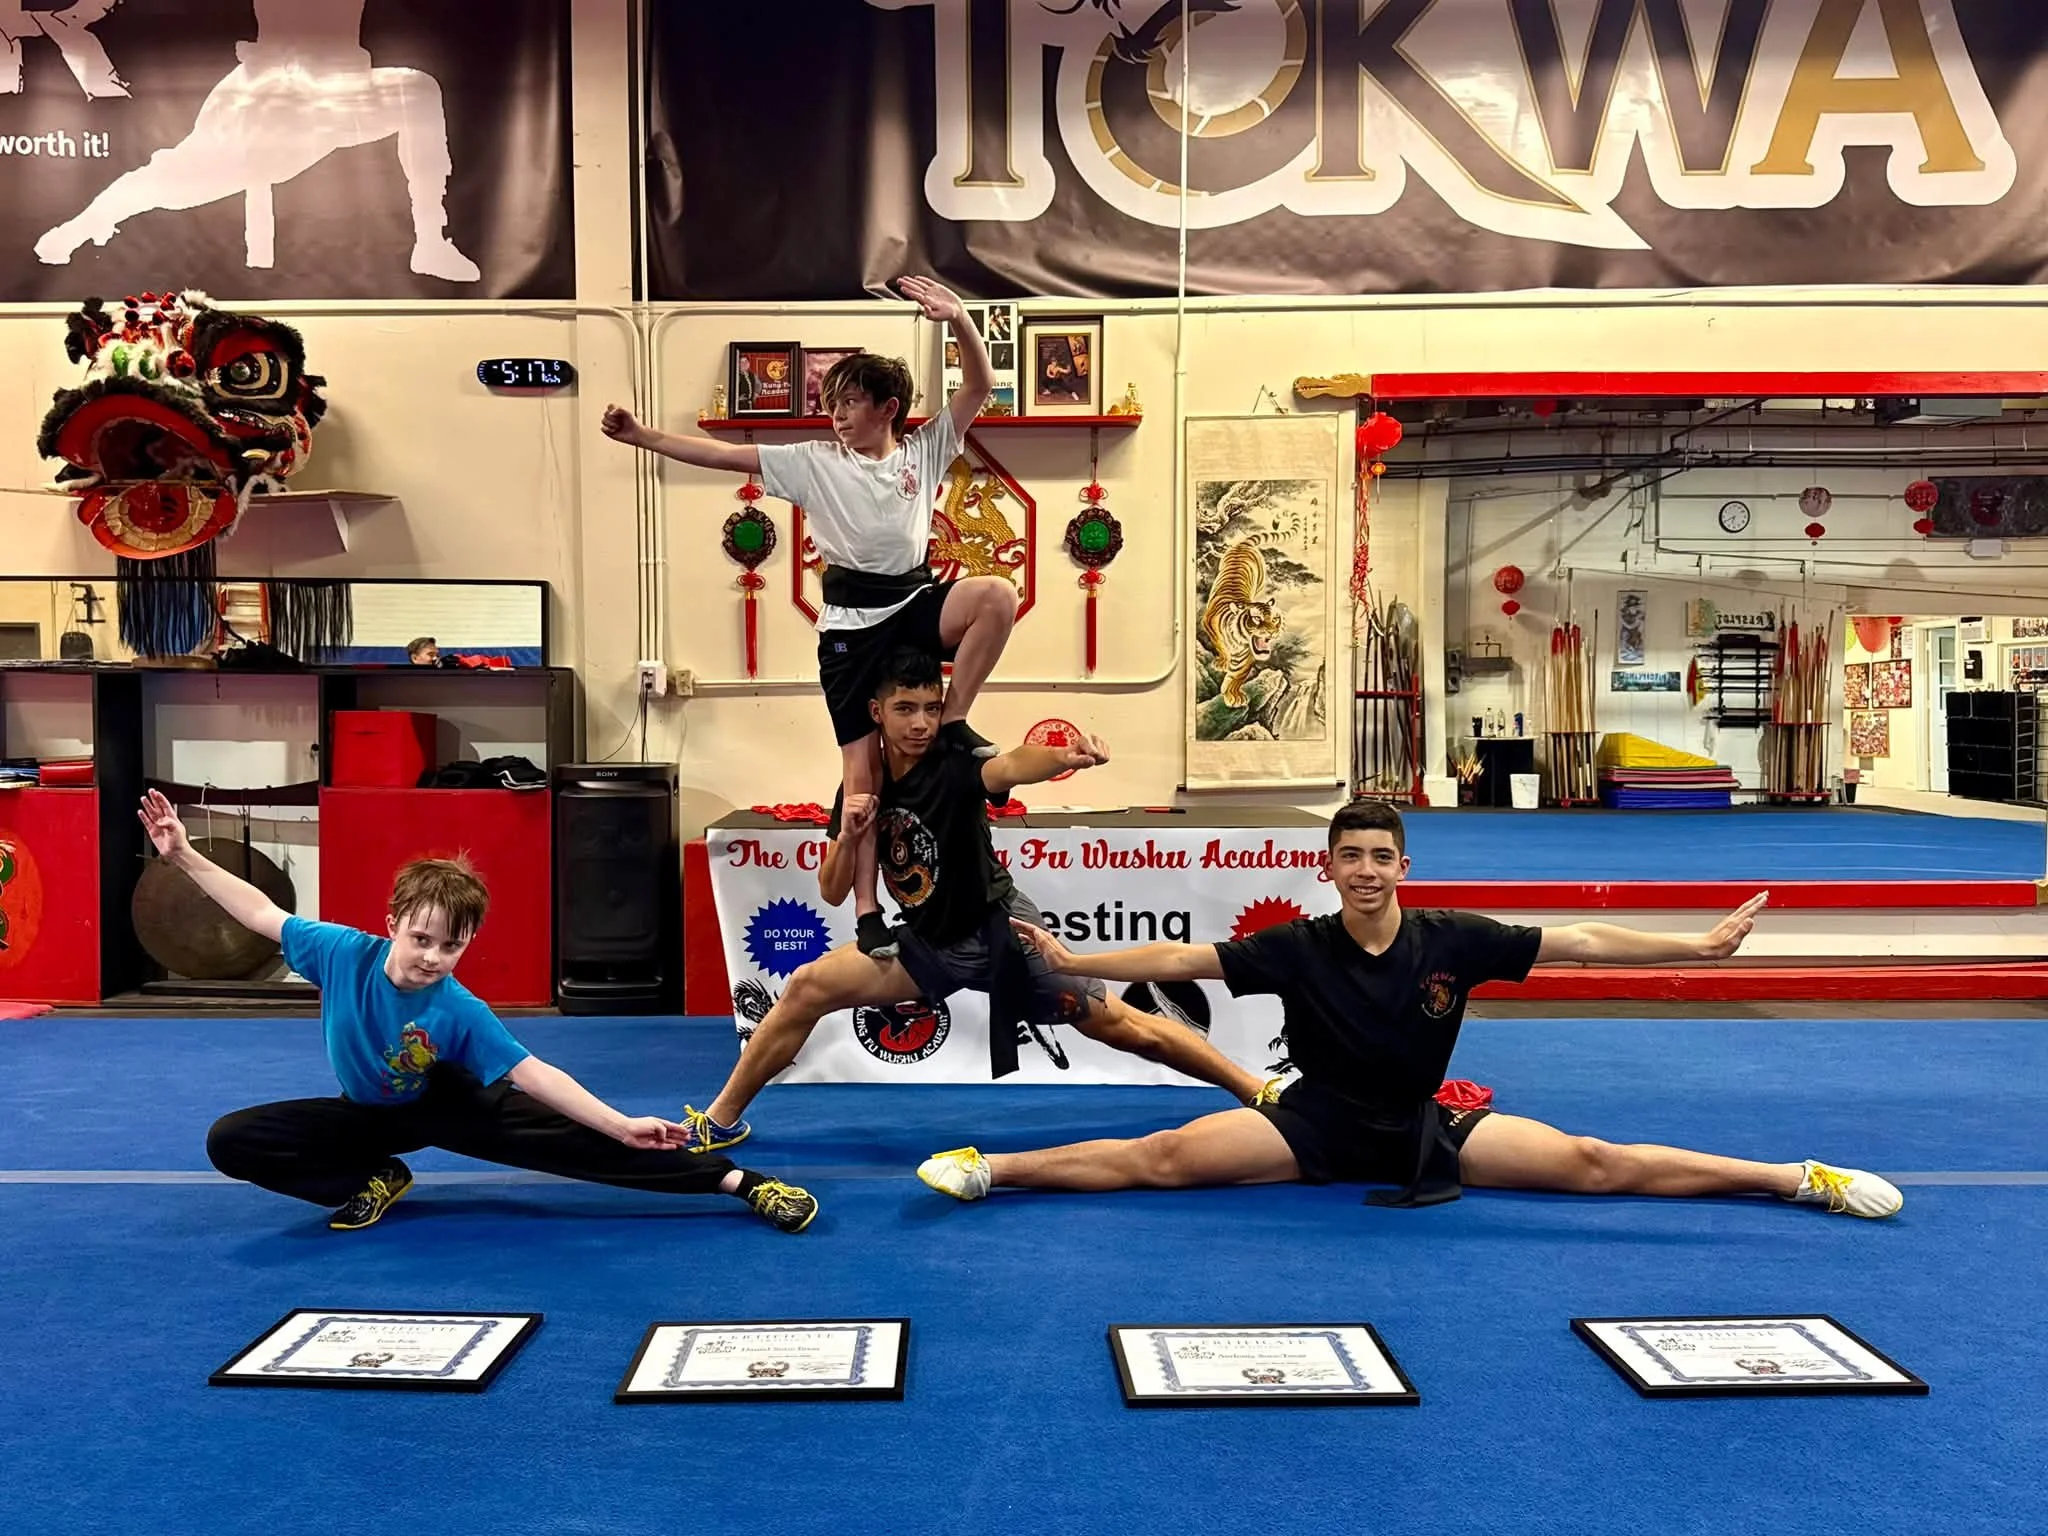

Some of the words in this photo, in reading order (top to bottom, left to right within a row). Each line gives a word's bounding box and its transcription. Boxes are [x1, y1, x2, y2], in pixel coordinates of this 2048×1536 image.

[83, 131, 110, 158] it!
[501, 361, 546, 384] 5:17
[727, 839, 789, 869] The
[1020, 839, 1073, 869] Fu
[1082, 839, 1192, 869] Wushu
[763, 929, 780, 939] DO
[783, 929, 815, 939] YOUR
[1041, 901, 1191, 944] esting
[774, 941, 807, 950] BEST!
[864, 1038, 879, 1053] FU
[879, 1049, 919, 1064] WUSHU
[922, 1014, 949, 1058] ACADEMY
